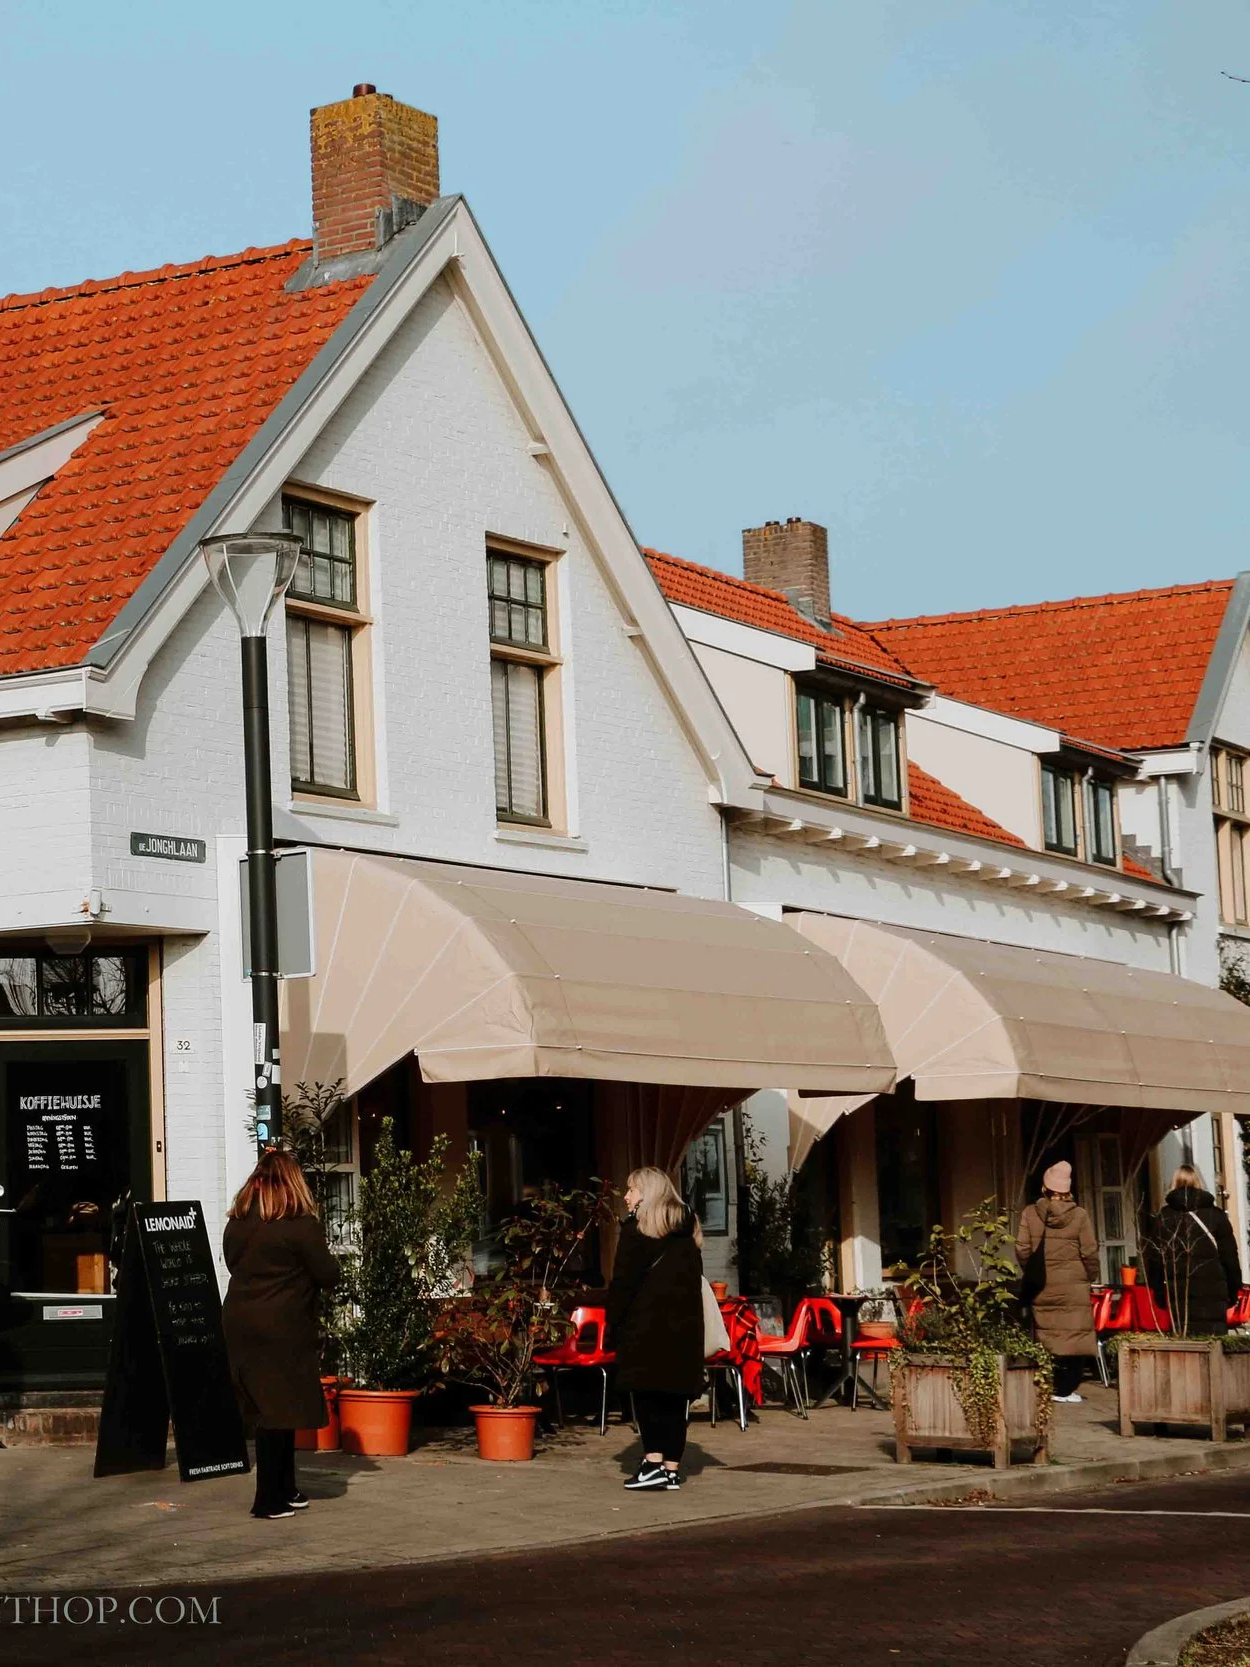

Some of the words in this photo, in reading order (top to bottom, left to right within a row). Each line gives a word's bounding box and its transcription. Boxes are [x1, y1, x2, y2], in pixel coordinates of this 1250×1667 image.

[146, 838, 198, 858] JONGHLAAN
[176, 1040, 191, 1051] 32
[19, 1095, 102, 1110] KOFFIEHUISJE
